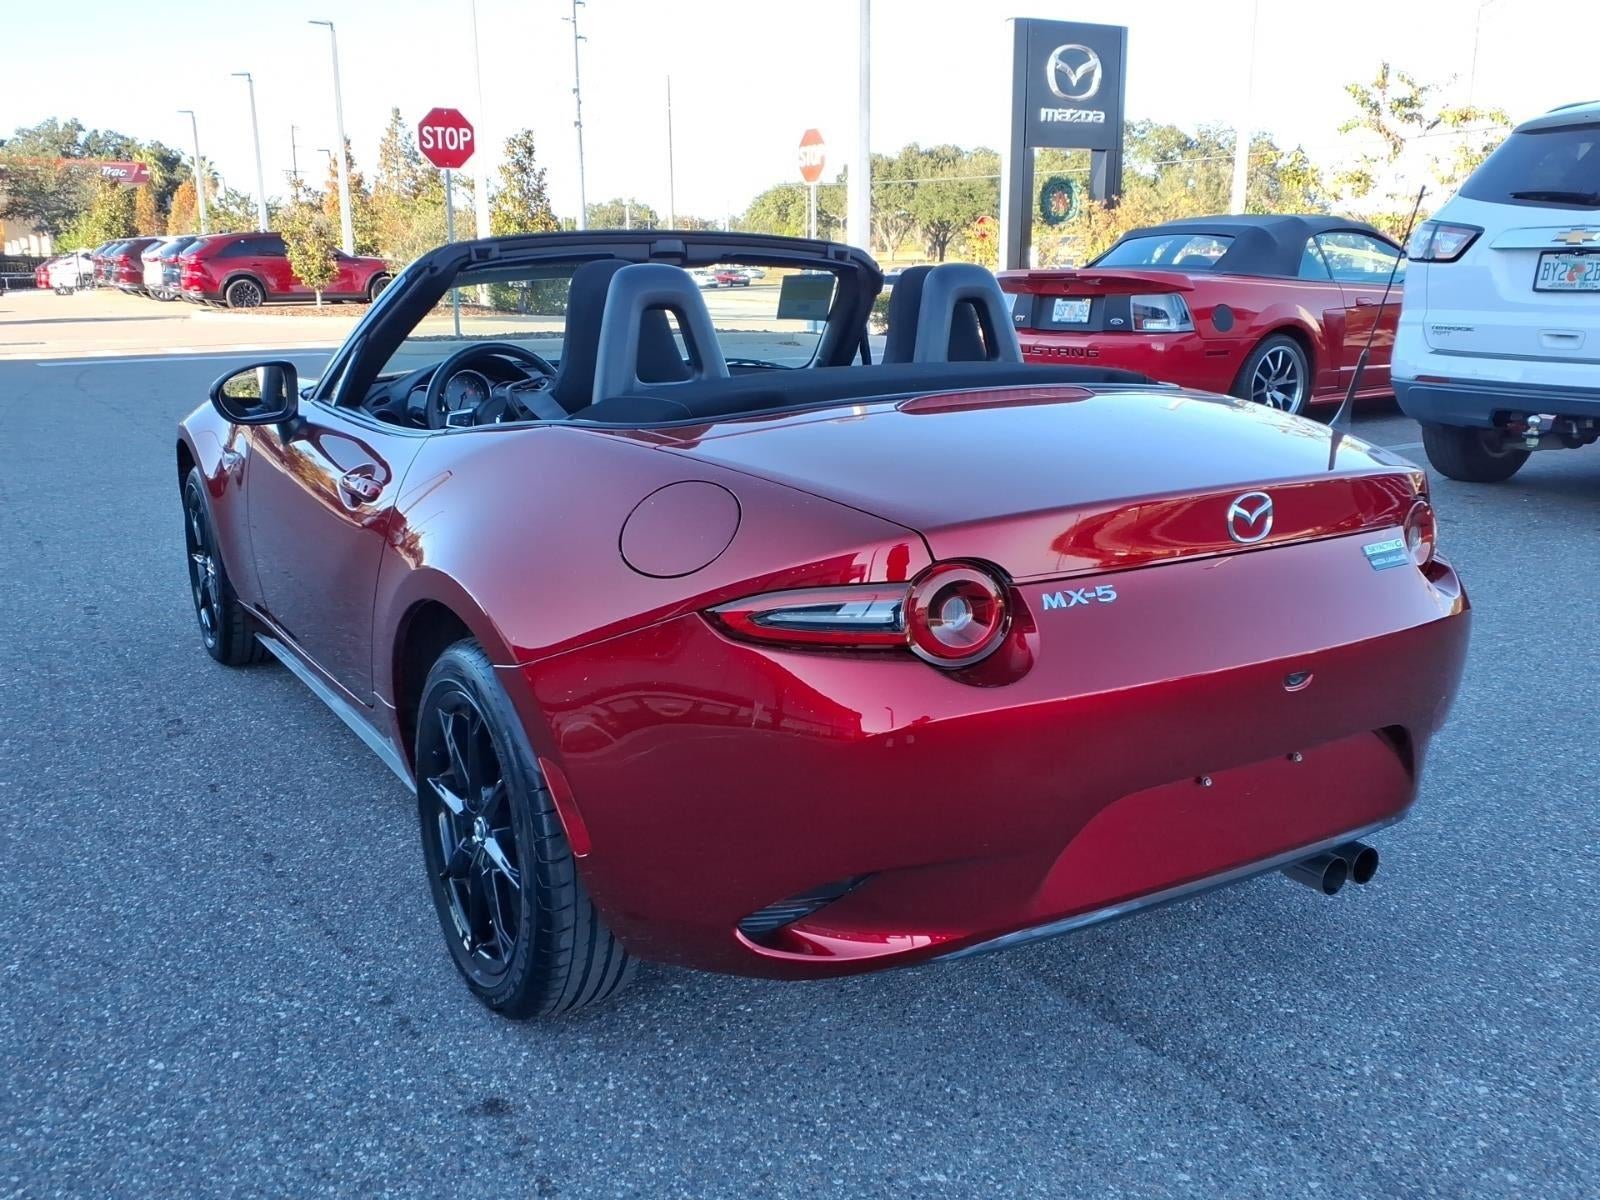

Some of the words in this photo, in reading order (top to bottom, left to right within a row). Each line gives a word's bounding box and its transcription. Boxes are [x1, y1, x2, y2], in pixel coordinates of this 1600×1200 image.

[1040, 107, 1106, 123] mazda
[422, 125, 472, 150] STOP
[1015, 314, 1026, 322] GT
[1020, 345, 1100, 358] USTANG
[1042, 584, 1118, 610] MX-5
